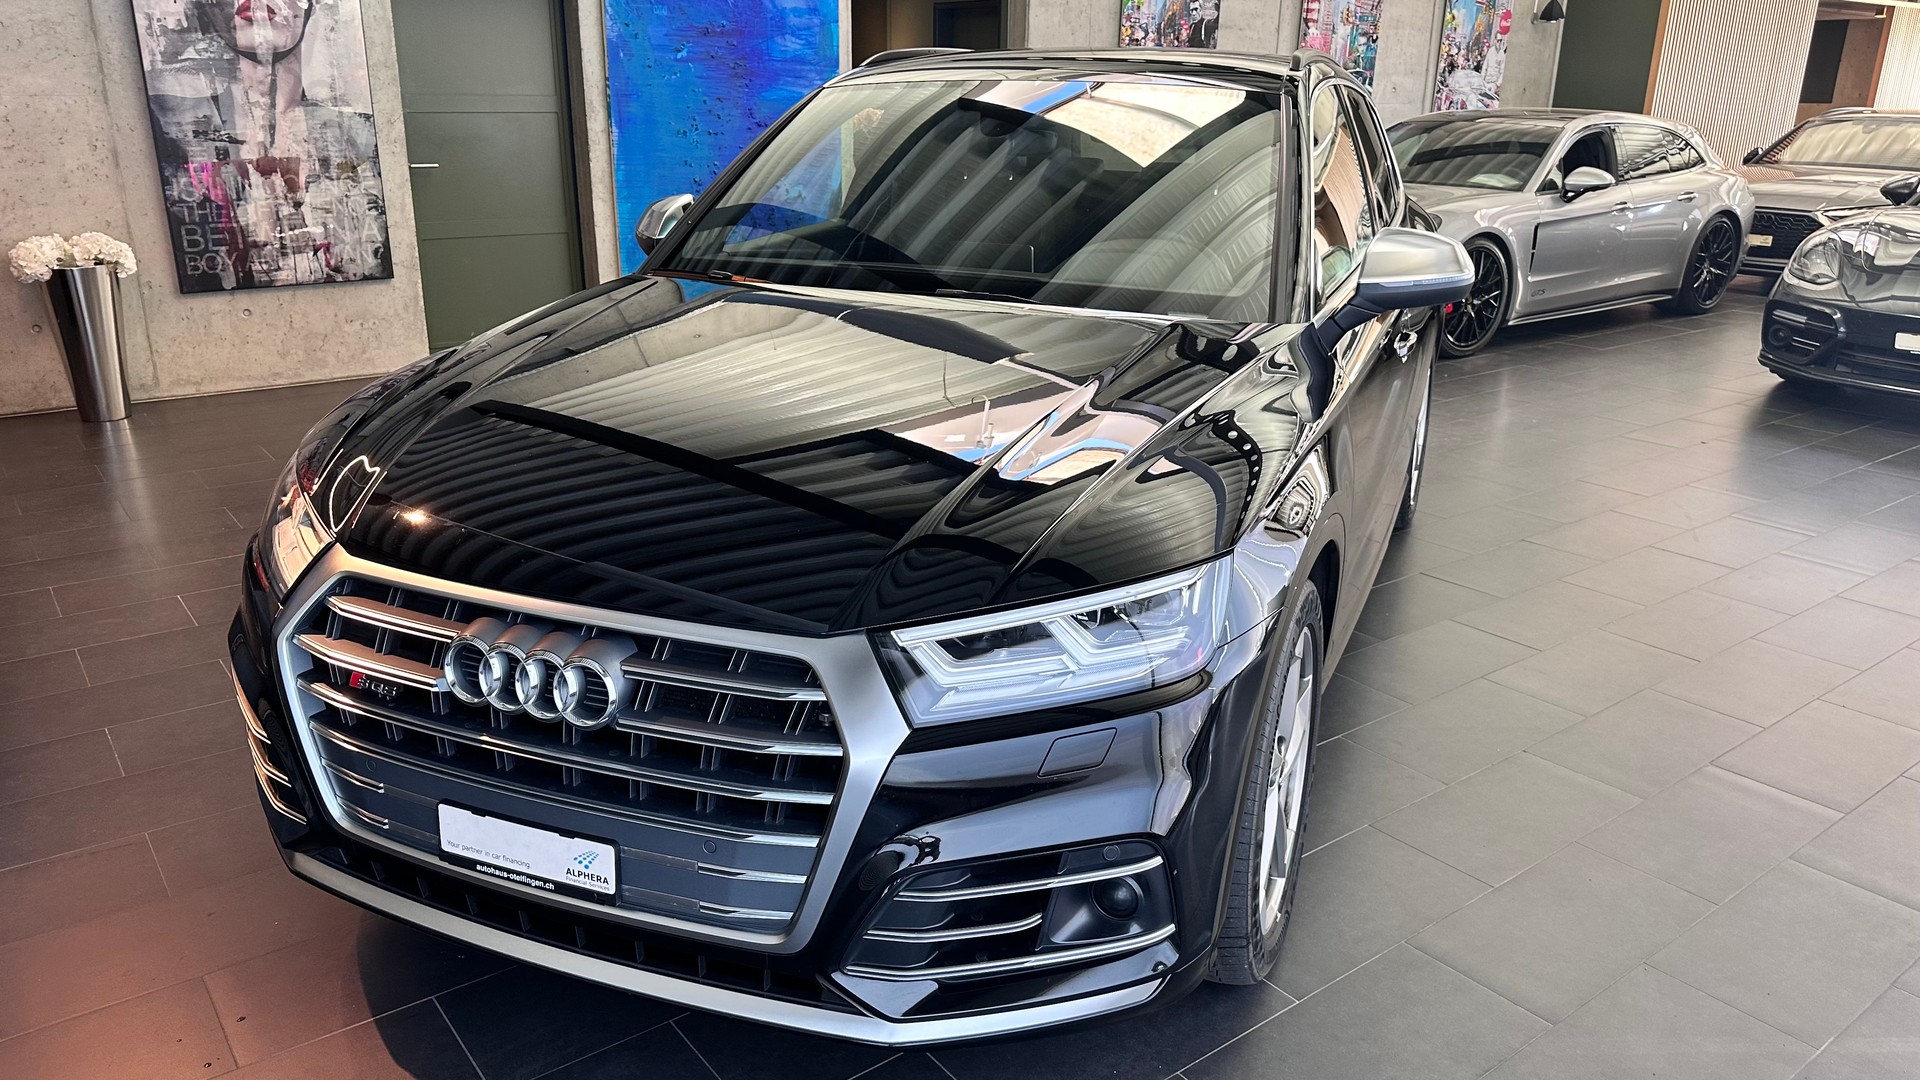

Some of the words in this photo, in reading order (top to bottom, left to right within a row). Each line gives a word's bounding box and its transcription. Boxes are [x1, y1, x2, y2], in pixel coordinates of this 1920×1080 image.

[446, 839, 460, 849] Your
[461, 842, 483, 855] partner
[484, 849, 491, 857] in
[491, 852, 501, 860] car
[475, 863, 555, 891] autohaus-otelfingen.ch
[565, 867, 609, 885] ALPHERA
[565, 876, 588, 886] Financial
[588, 881, 610, 892] Services
